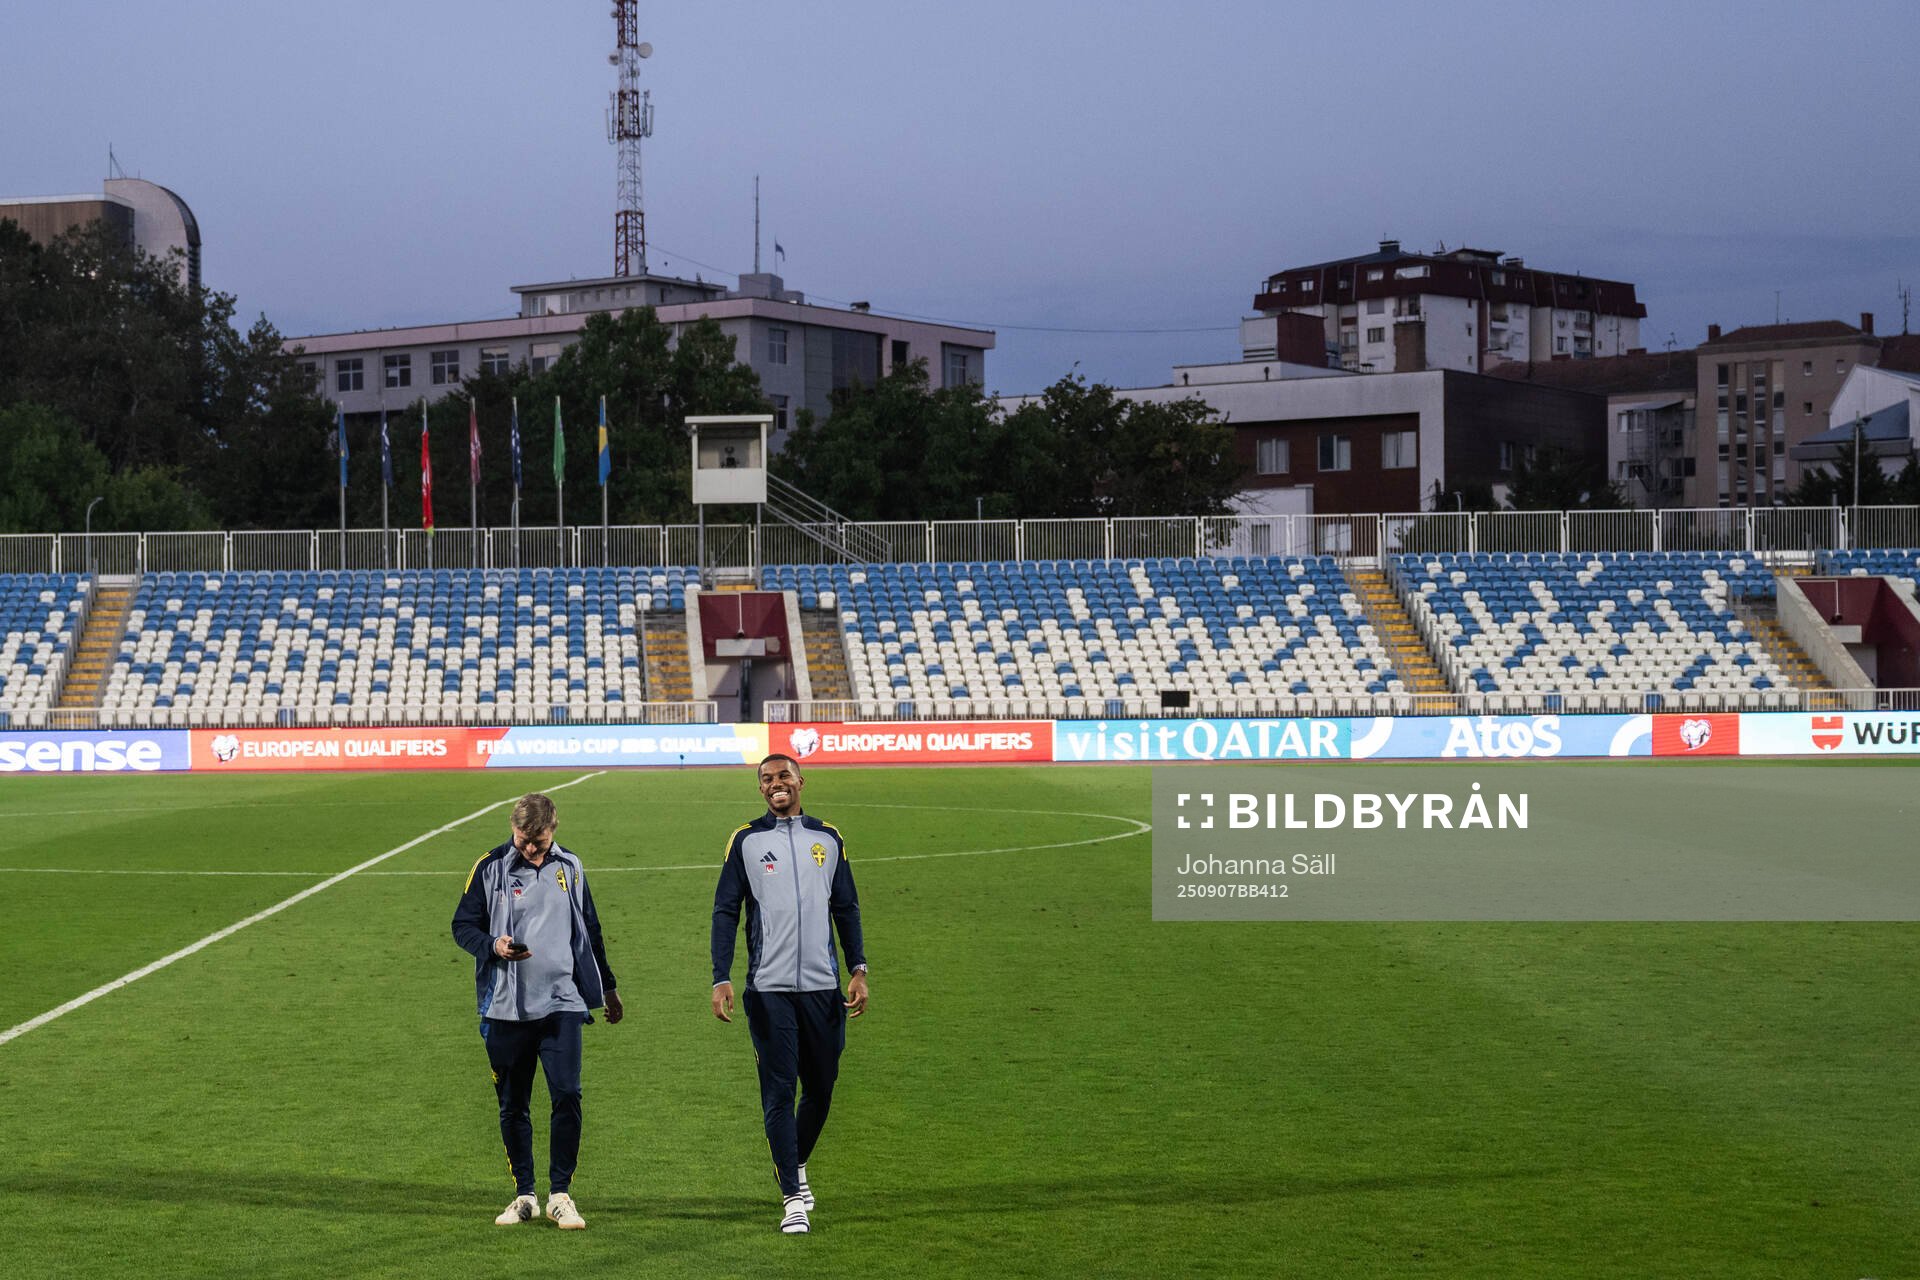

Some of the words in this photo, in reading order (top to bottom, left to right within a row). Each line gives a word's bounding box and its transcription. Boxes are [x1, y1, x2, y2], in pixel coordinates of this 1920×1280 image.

[243, 741, 339, 757] EUROPEAN
[345, 740, 447, 756] QUALIFIERS
[477, 739, 515, 754] FIFA
[517, 739, 580, 754] WORLD
[583, 738, 619, 754] CUP
[660, 737, 758, 752] QUALIFI
[822, 734, 921, 751] EUROPEAN
[927, 733, 1033, 750] QUALIFIERS
